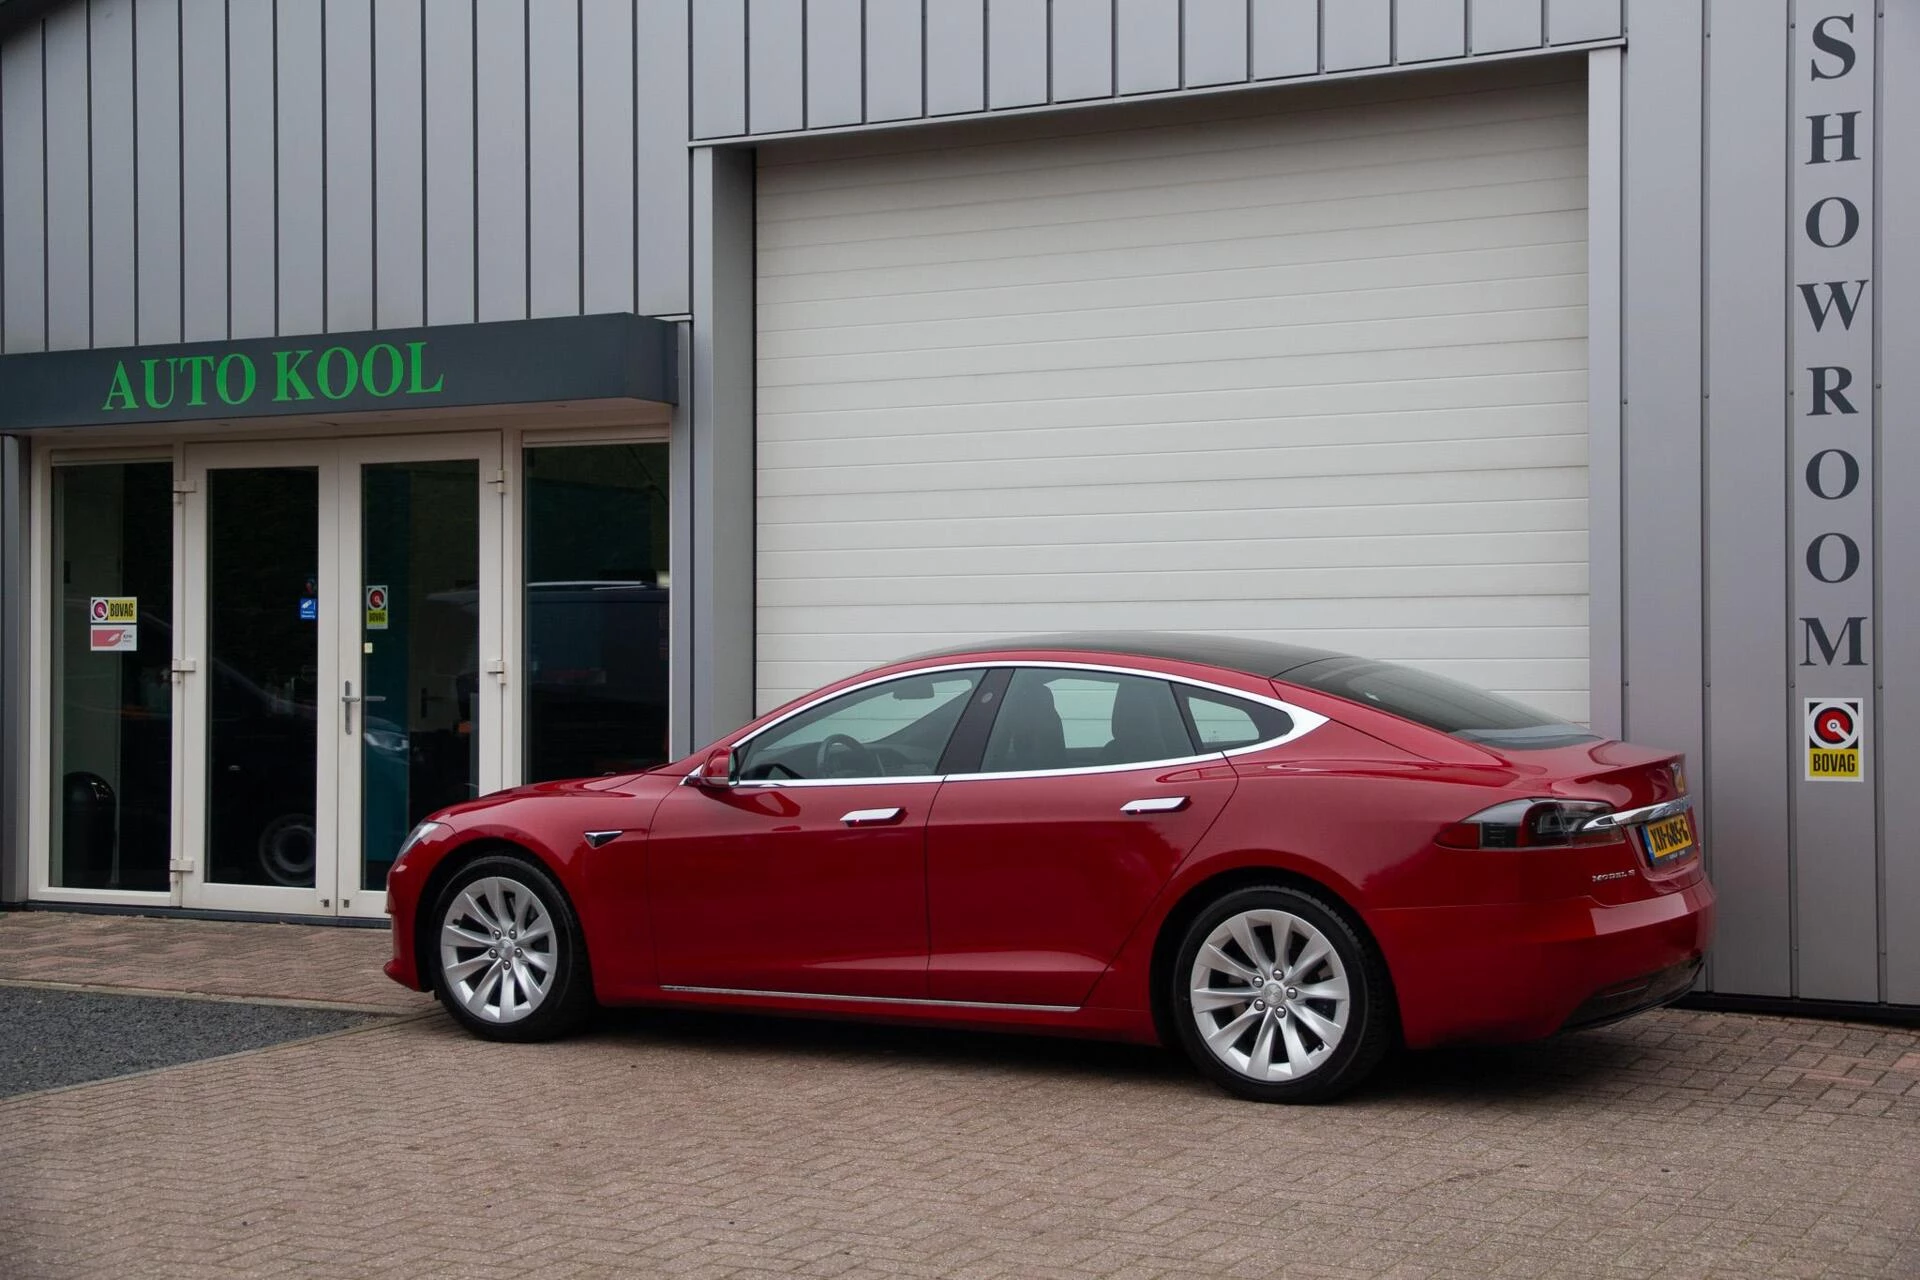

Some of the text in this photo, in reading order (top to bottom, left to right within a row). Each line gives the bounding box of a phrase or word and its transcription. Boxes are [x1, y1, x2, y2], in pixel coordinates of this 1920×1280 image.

[1796, 13, 1869, 666] SHOWROOM
[103, 341, 444, 410] AUTO KOOL
[110, 603, 134, 617] BOVAG
[368, 612, 386, 623] BOVAG
[1813, 753, 1855, 772] BOVAG
[1591, 871, 1627, 883] MODEL
